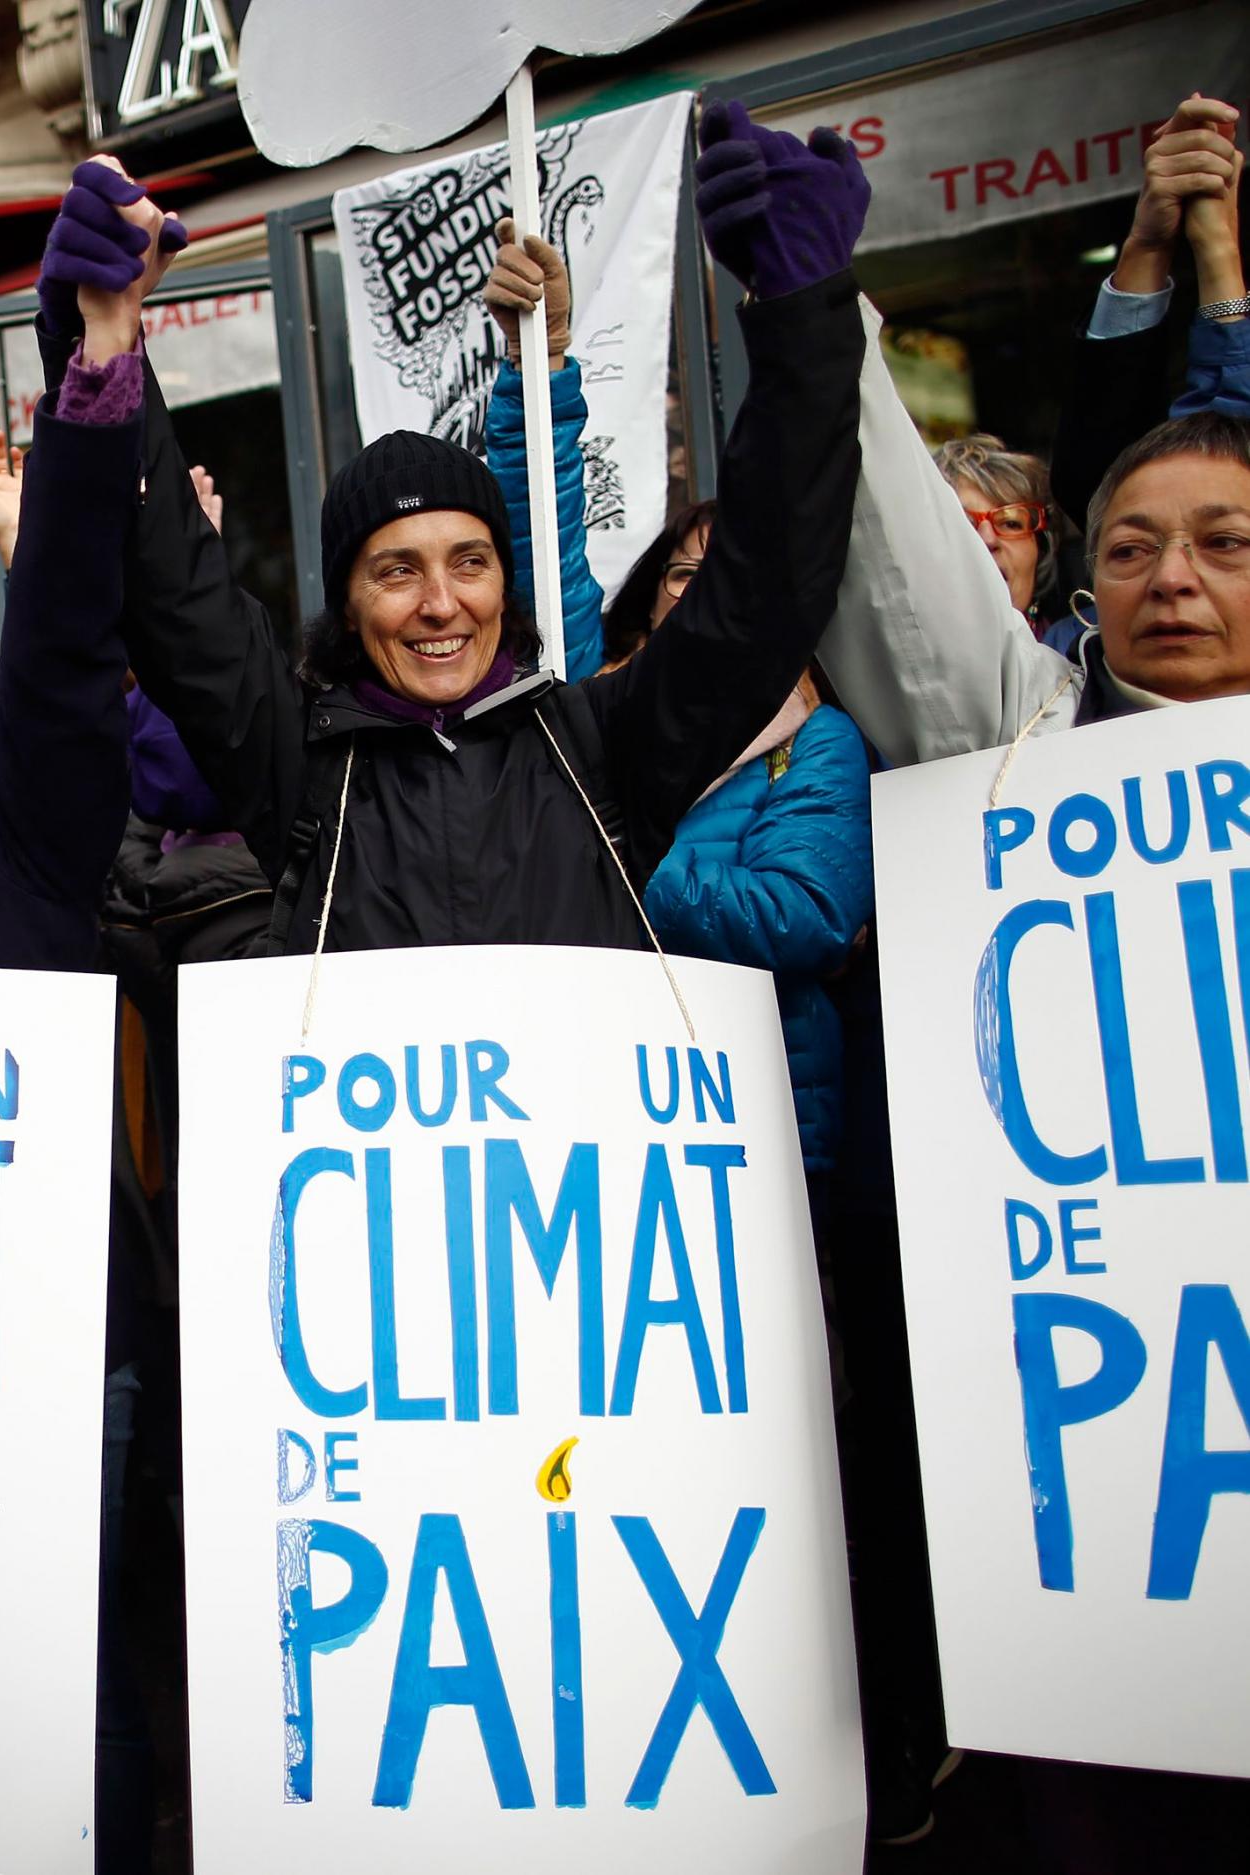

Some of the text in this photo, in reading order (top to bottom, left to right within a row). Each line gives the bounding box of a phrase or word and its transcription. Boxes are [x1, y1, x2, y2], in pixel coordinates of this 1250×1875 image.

[375, 174, 456, 261] STOP
[386, 176, 514, 299] FUNDIN
[981, 758, 1250, 890] POUR
[281, 1038, 735, 1134] POUR UN
[973, 867, 1250, 1187] CLI
[268, 1138, 750, 1422] CLIMAT
[1004, 1197, 1107, 1281] DE
[276, 1428, 361, 1507] DE
[275, 1507, 778, 1812] PAIX
